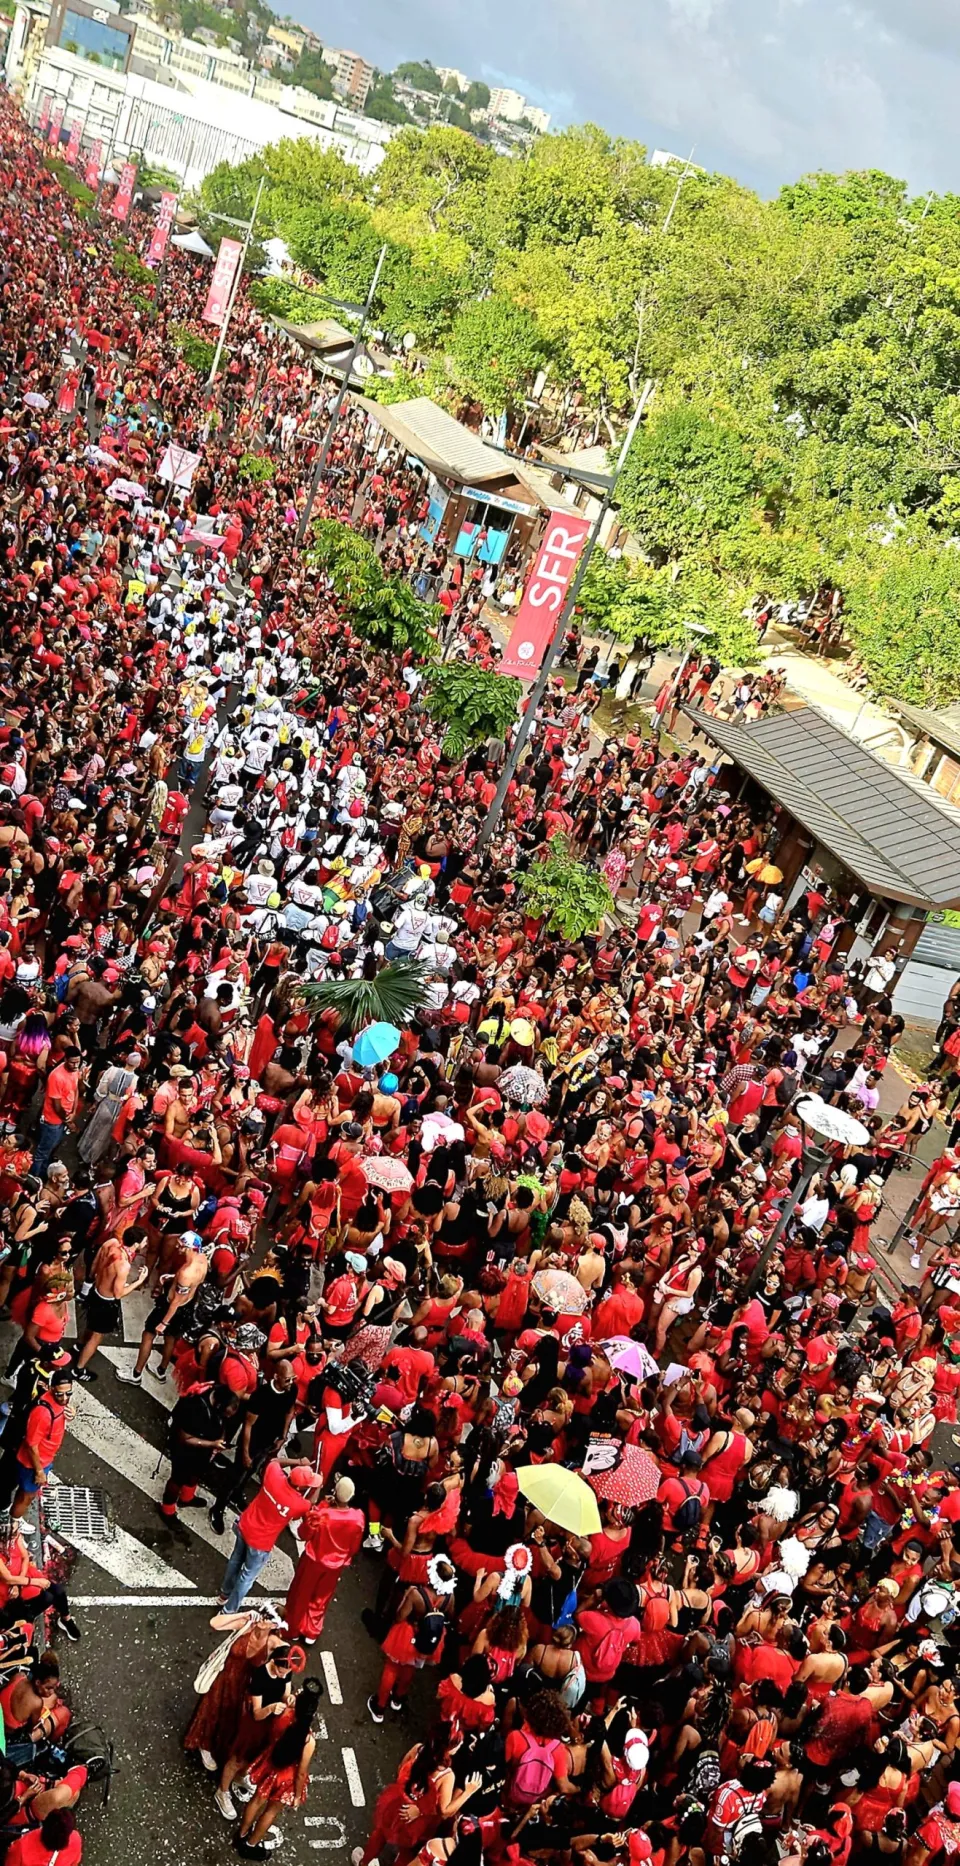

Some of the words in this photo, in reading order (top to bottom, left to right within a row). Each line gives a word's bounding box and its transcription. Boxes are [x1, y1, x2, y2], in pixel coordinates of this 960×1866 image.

[120, 168, 136, 195] SFR
[158, 198, 175, 229] SFR
[216, 247, 237, 287] SFR
[529, 527, 584, 611] SFR
